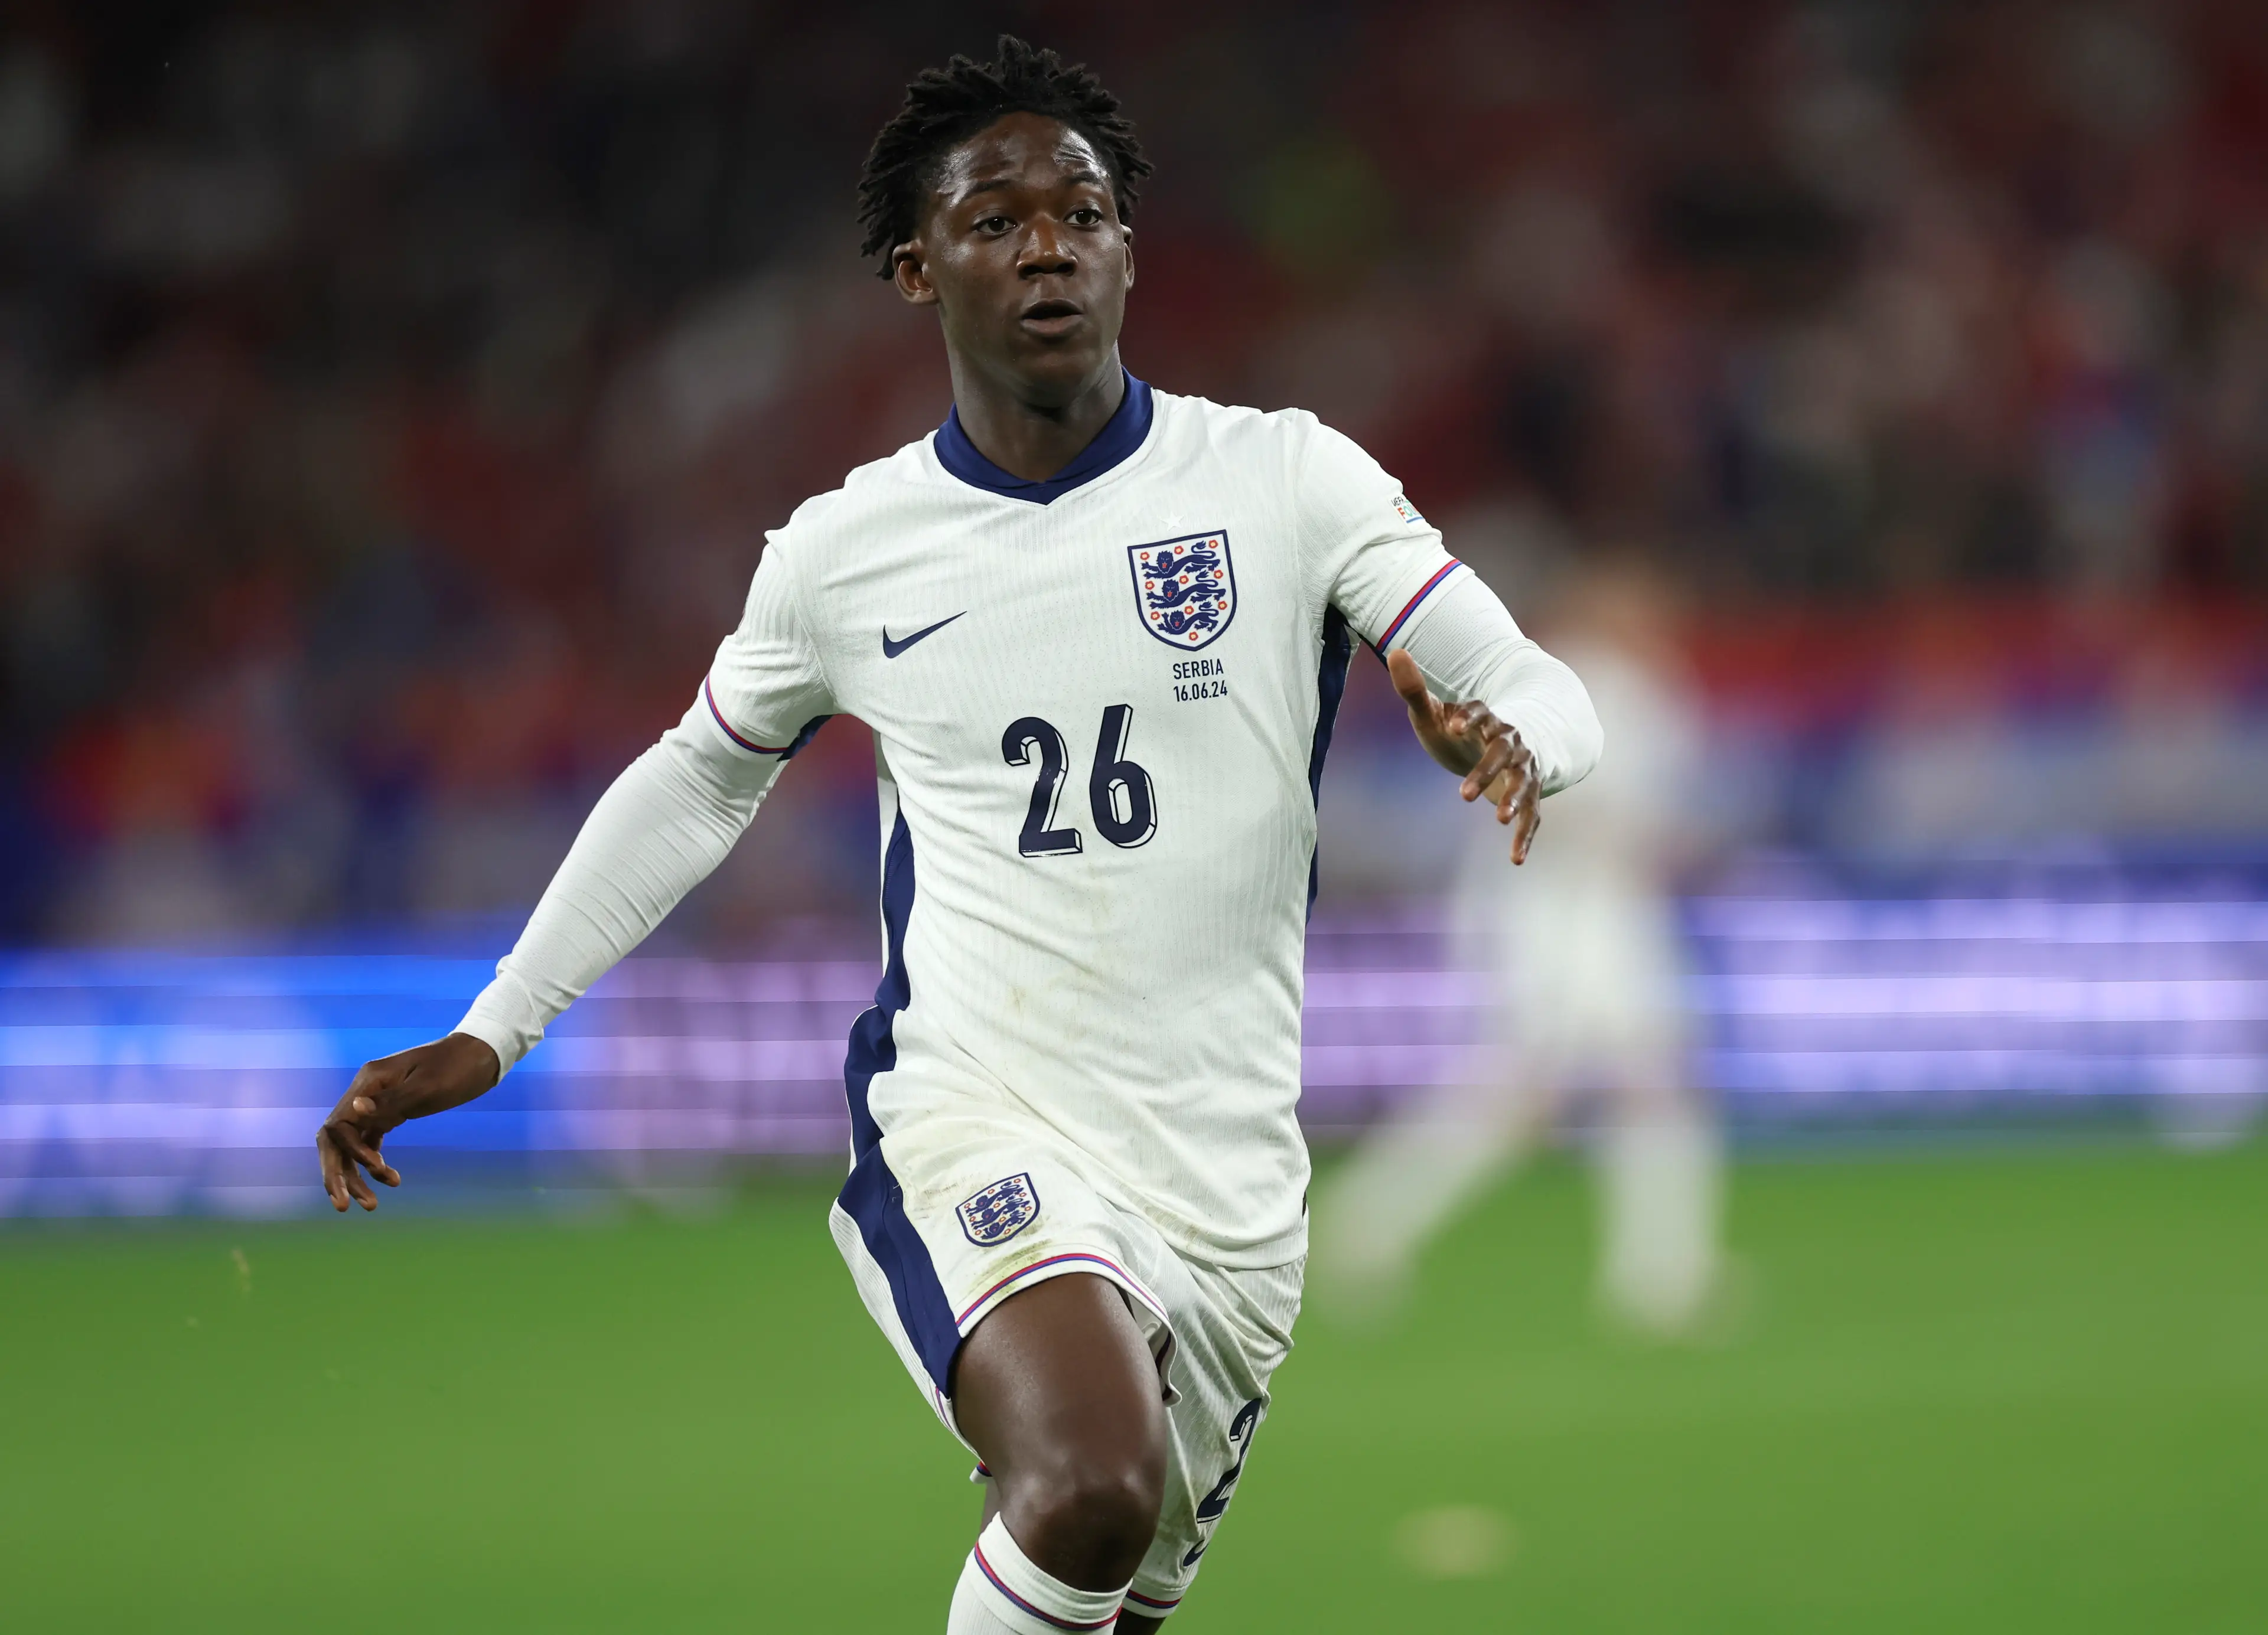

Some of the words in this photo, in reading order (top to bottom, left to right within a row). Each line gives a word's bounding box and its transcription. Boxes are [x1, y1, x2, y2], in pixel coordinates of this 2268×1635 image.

[1172, 658, 1224, 680] SERBIA
[1173, 680, 1228, 702] 16.06.24
[1002, 703, 1158, 858] 26
